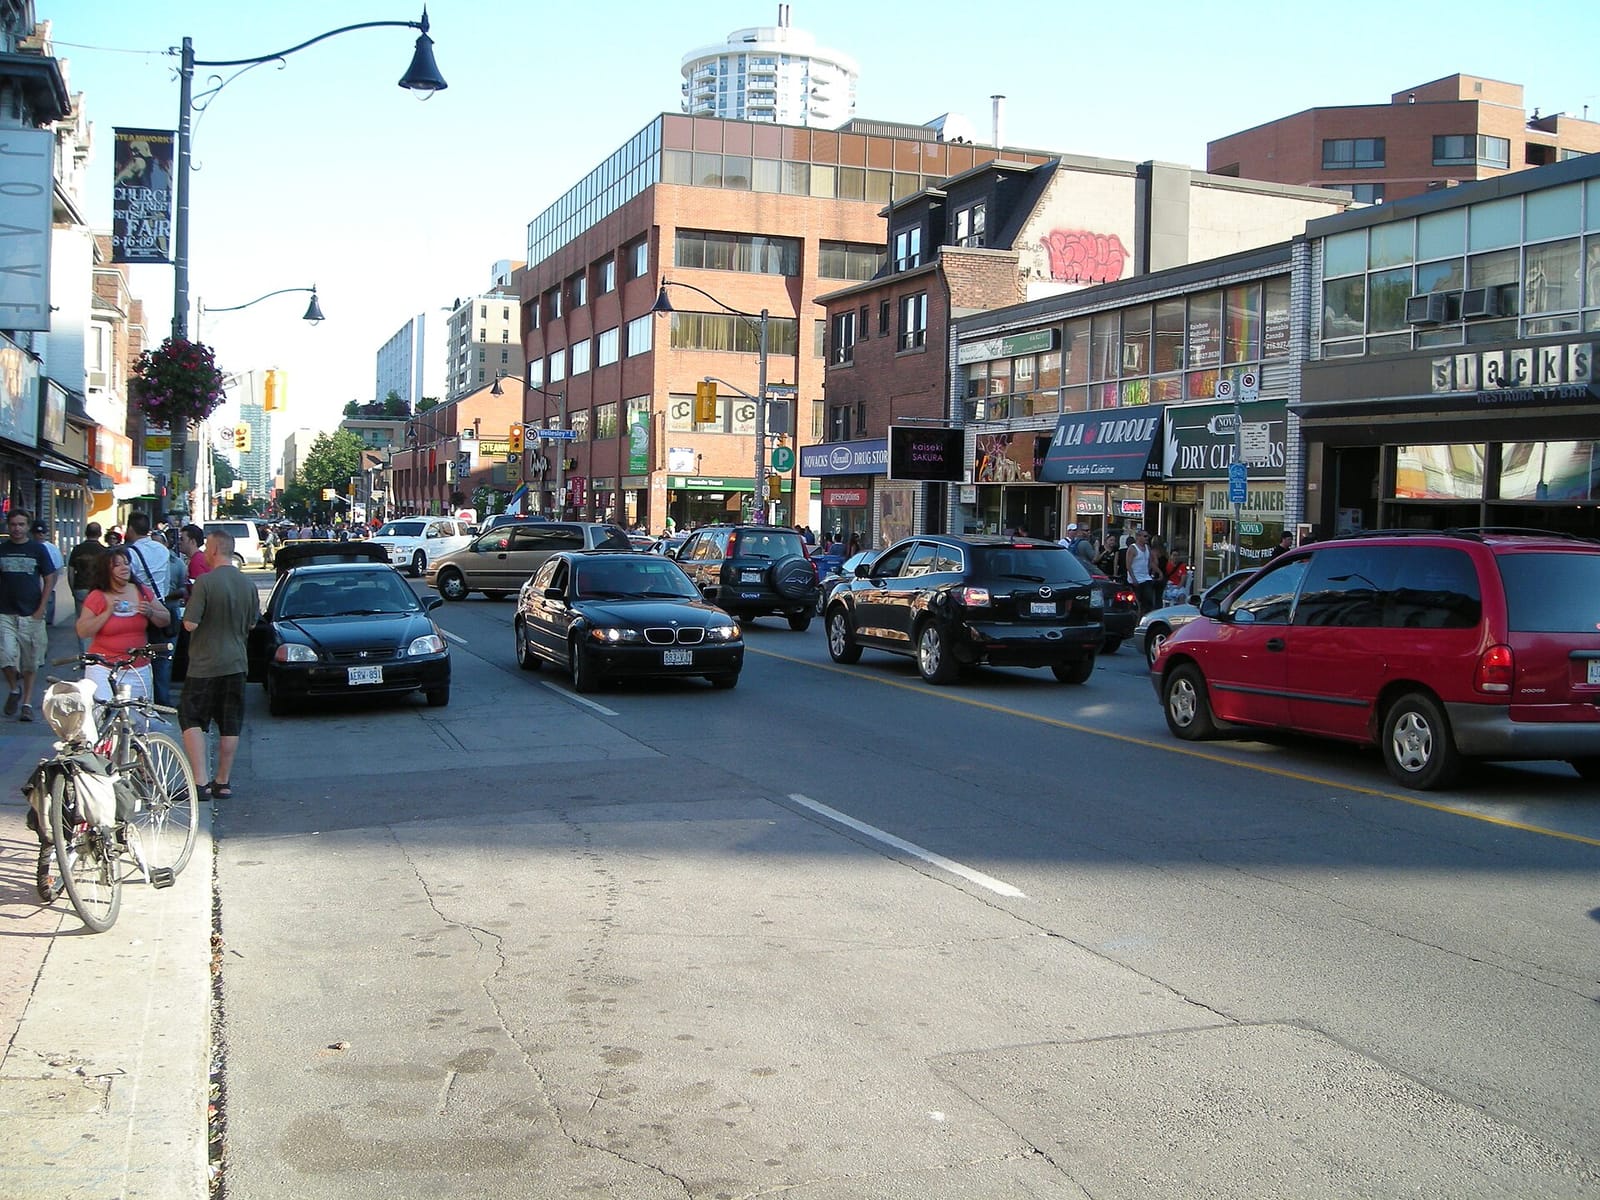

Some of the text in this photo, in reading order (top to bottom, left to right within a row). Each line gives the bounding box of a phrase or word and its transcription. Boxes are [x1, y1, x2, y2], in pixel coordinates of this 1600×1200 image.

[1436, 349, 1587, 387] slack's
[1096, 417, 1157, 444] TURQUE
[912, 443, 943, 451] kaiseki
[854, 451, 871, 465] DRUG
[912, 453, 944, 462] SAKURA
[1181, 445, 1208, 470] DRY
[1211, 441, 1284, 469] CLERS
[1067, 463, 1115, 475] Turkish Cuisine
[1241, 524, 1260, 533] NOVA
